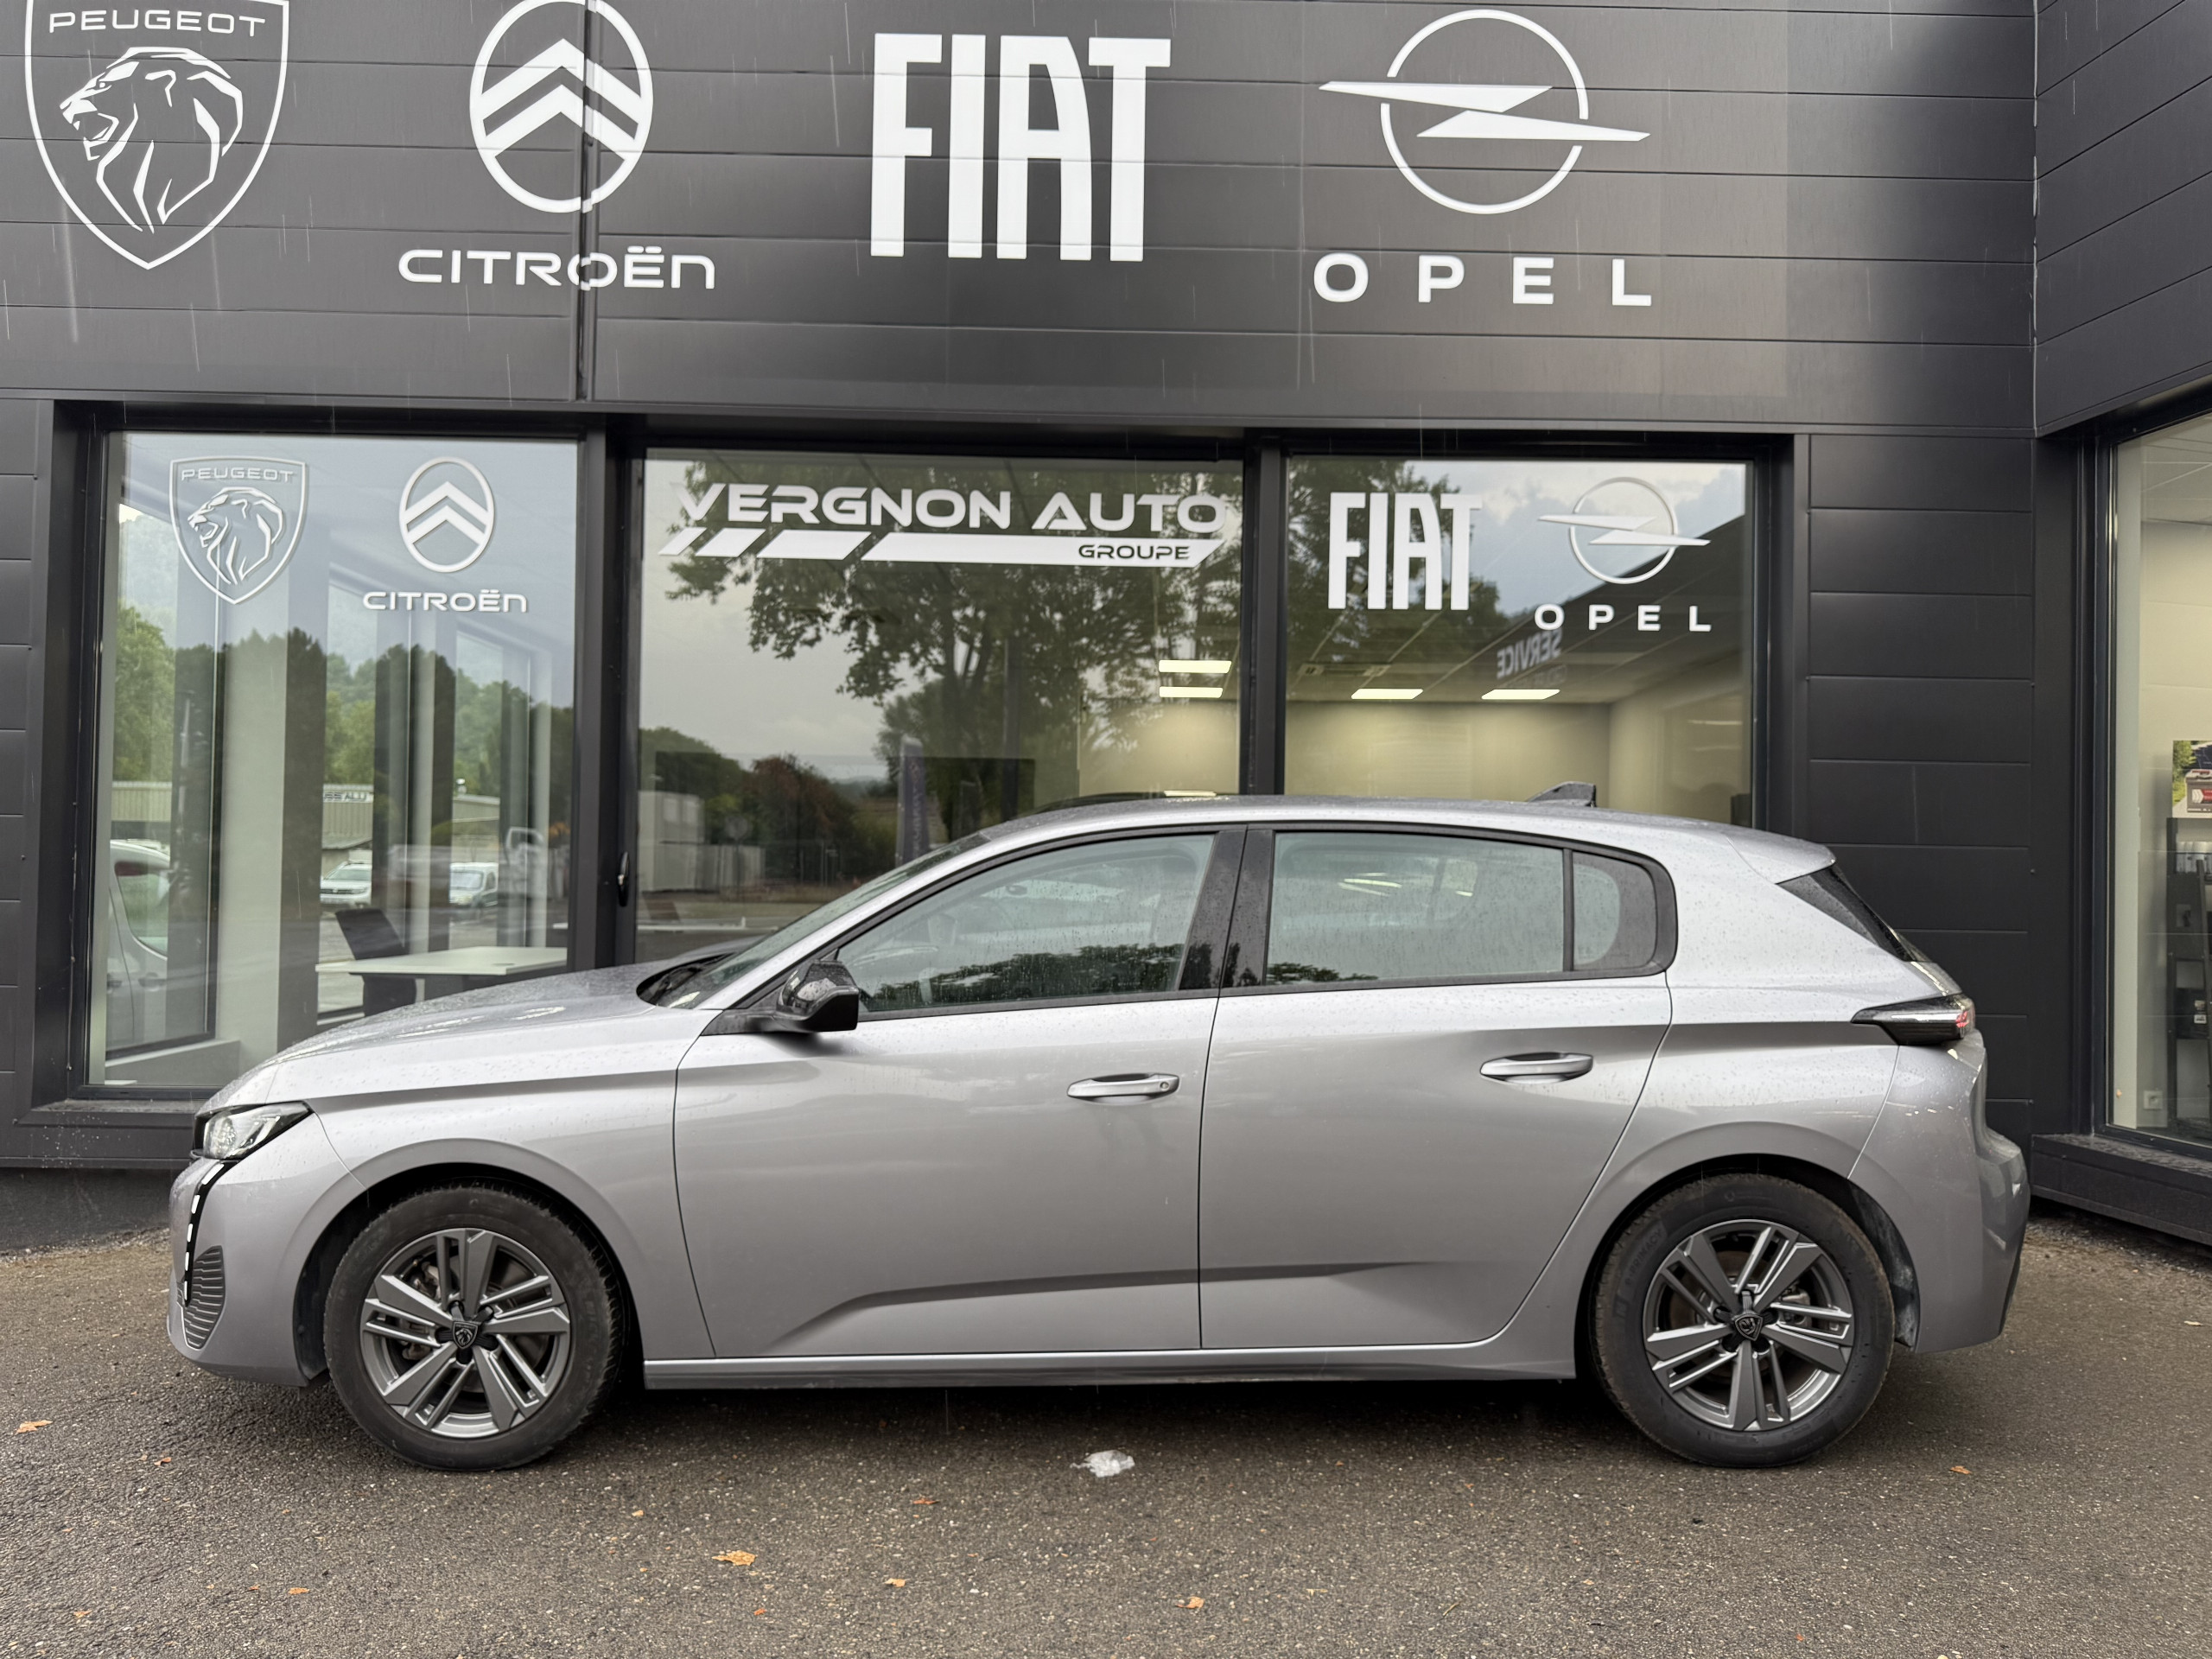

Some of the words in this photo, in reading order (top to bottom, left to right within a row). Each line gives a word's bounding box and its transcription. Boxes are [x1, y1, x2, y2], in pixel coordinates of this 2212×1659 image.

[48, 9, 266, 37] PEUGEOT
[870, 32, 1172, 262] FIAT
[1313, 251, 1652, 306] OPEL
[181, 467, 294, 483] PEUGEOT
[671, 482, 1011, 530] VERGNON
[1031, 491, 1226, 533] AUTO
[1078, 543, 1191, 560] GROUPE
[1328, 492, 1483, 610] FIAT
[362, 589, 527, 613] CITROËN
[1534, 603, 1712, 632] OPEL
